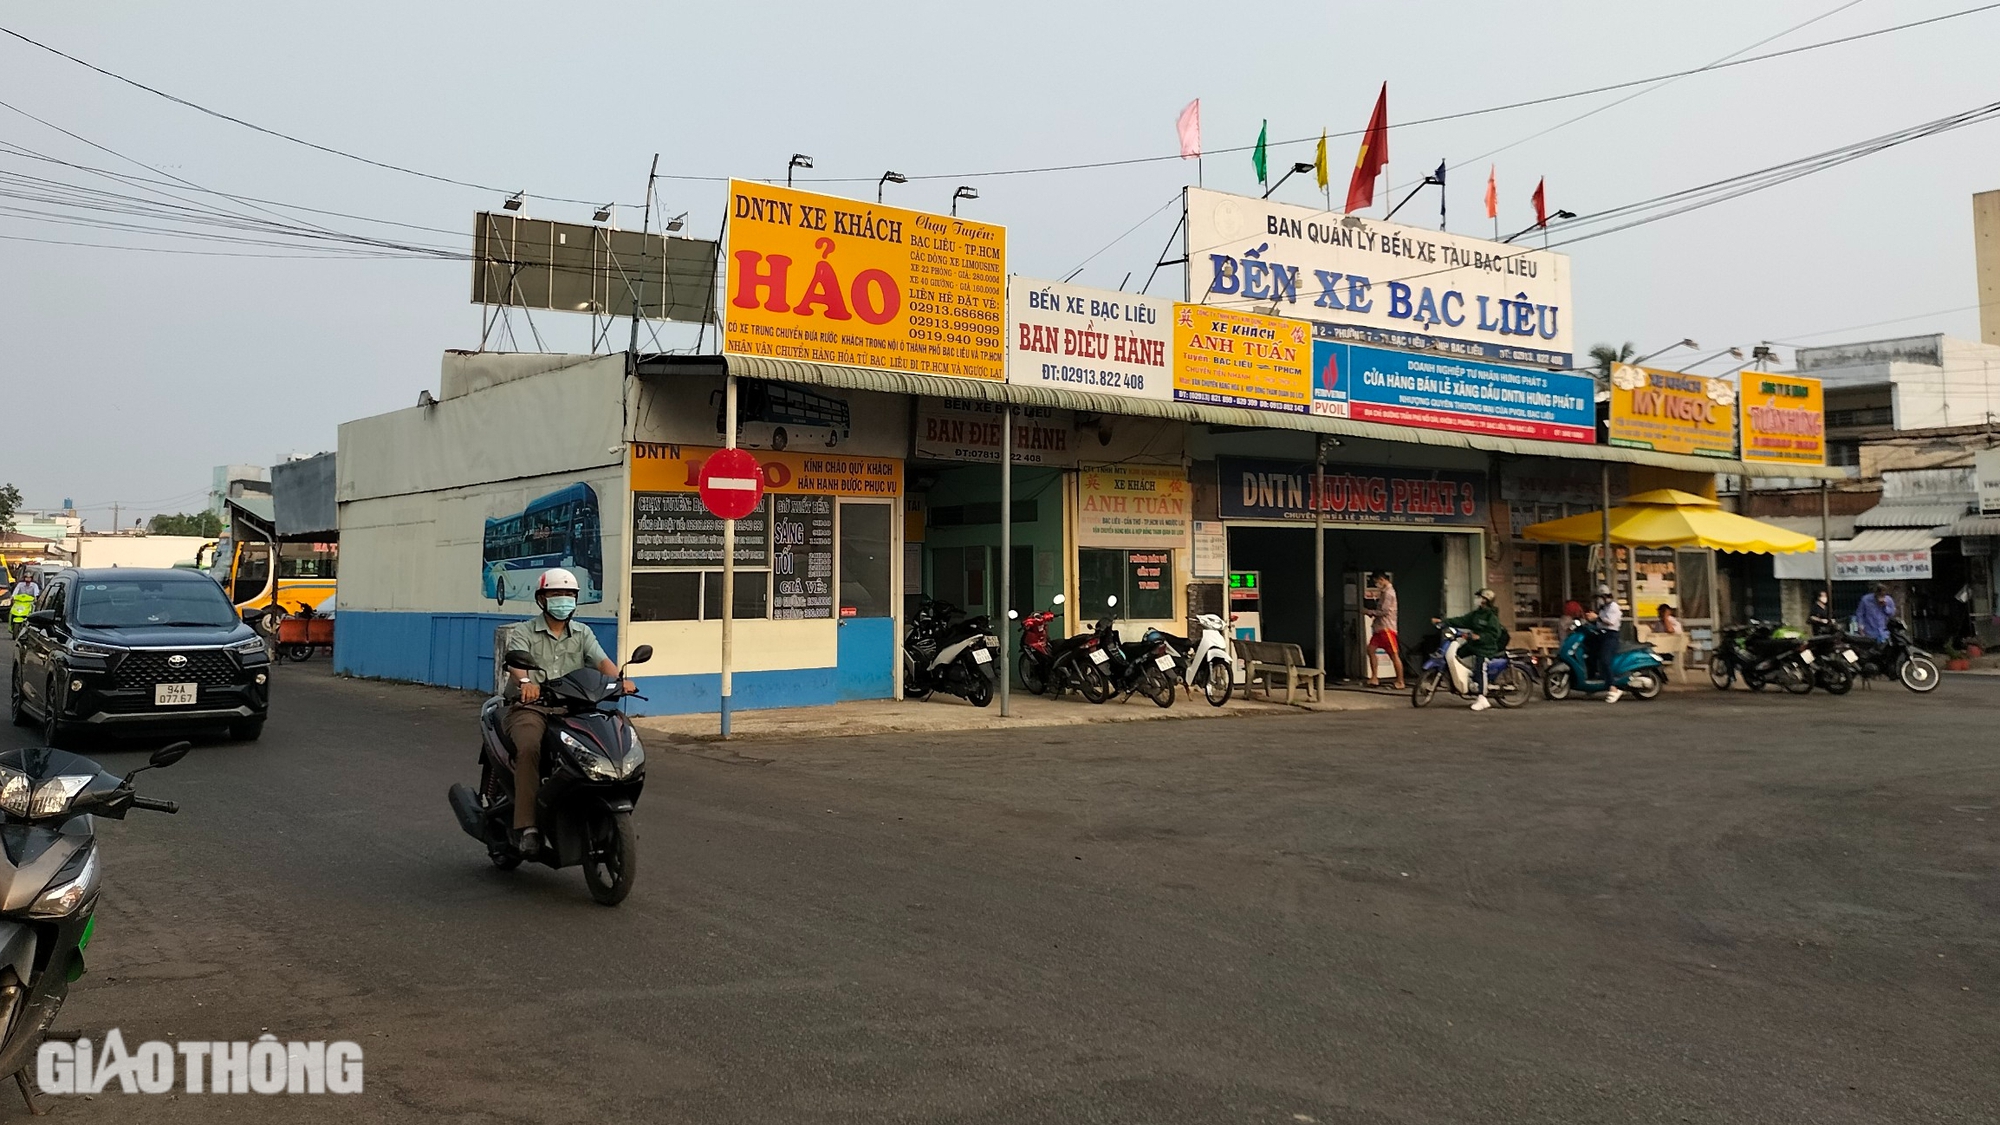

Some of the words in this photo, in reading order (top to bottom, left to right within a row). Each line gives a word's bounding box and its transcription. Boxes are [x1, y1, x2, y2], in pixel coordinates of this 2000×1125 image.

[736, 195, 792, 225] DNTN
[799, 205, 827, 231] XE
[834, 210, 902, 243] KHÁCH
[916, 215, 947, 235] Chạy
[952, 222, 994, 240] Tuyến:
[910, 235, 930, 249] BẠC
[934, 238, 955, 252] LIÊU
[965, 244, 1000, 259] TP.HCM
[1268, 215, 1302, 239] BAN
[1308, 218, 1353, 248] QUẢN
[1358, 228, 1378, 251] LÝ
[1417, 240, 1436, 263] XE
[1441, 242, 1470, 266] TÀU
[1474, 251, 1501, 275] BẠC
[1506, 255, 1537, 278] LIÊU
[910, 250, 925, 261] CÁC
[927, 252, 947, 265] DÒNG
[950, 257, 959, 267] XE
[962, 259, 999, 272] LIMOUSINE
[921, 265, 929, 273] 22
[931, 266, 952, 276] PHÒNG
[733, 237, 901, 325] HẢO
[921, 277, 928, 285] 40
[930, 279, 954, 289] GIƯỜNG
[1209, 243, 1299, 304] BẾN
[1314, 270, 1373, 313] XE
[1387, 281, 1465, 331] BẠC
[1476, 292, 1558, 339] LIÊU
[909, 288, 934, 301] LIÊN
[939, 292, 953, 305] HỆ
[958, 295, 979, 307] ĐẶT
[983, 298, 999, 309] VÉ:
[1030, 287, 1060, 311] BẾN
[1066, 296, 1084, 315] XE
[1091, 300, 1120, 321] BẠC
[1125, 304, 1156, 324] LIÊU
[910, 302, 999, 322] 02913.686868
[909, 316, 999, 335] 02913.999099
[1211, 322, 1228, 333] XE
[1232, 325, 1275, 340] KHÁCH
[728, 322, 737, 332] CÓ
[740, 324, 748, 334] XE
[751, 325, 774, 336] TRUNG
[776, 325, 802, 340] CHUYỂN
[805, 330, 818, 341] ĐƯA
[821, 331, 838, 343] RƯỚC
[842, 335, 863, 347] KHÁCH
[866, 338, 886, 349] TRONG
[888, 341, 898, 351] NỘI
[906, 342, 927, 353] THÀNH
[929, 344, 940, 355] PHỐ
[943, 347, 954, 358] BẠC
[956, 349, 969, 358] LIÊU
[971, 350, 978, 359] VÀ
[981, 351, 1002, 362] TP.HCM
[909, 329, 971, 344] 0919.940
[976, 337, 999, 347] 990
[1019, 323, 1059, 354] BAN
[1064, 320, 1109, 360] ĐIỀU
[1114, 330, 1165, 367] HÀNH
[1189, 334, 1234, 353] ANH
[1243, 340, 1297, 362] TUẤN
[728, 339, 752, 353] NHẬN
[756, 342, 773, 356] VẬN
[776, 343, 809, 358] CHUYỂN
[812, 348, 835, 361] HÀNG
[838, 349, 854, 363] HÓA
[857, 352, 868, 364] TỪ
[870, 355, 886, 367] BẠC
[890, 356, 908, 368] LIÊU
[910, 360, 918, 369] ĐI
[921, 361, 949, 373] TP.HCM
[951, 362, 961, 374] VÀ
[964, 365, 987, 377] NGƯỢC
[990, 369, 1002, 378] LẠI
[1214, 357, 1230, 365] BẠC
[1234, 360, 1252, 368] LIÊU
[1274, 366, 1301, 375] TPHCM
[1407, 360, 1435, 373] DOANH
[1124, 373, 1143, 390] 408
[1364, 367, 1385, 386] CỬA
[1386, 372, 1415, 390] HÀNG
[1417, 376, 1437, 393] BÁN
[1440, 377, 1451, 395] LẺ
[1453, 381, 1479, 398] XĂNG
[1502, 389, 1525, 403] DNTN
[1526, 391, 1551, 406] HƯNG
[1552, 393, 1575, 410] PHÁT
[974, 402, 991, 413] XE
[1315, 402, 1345, 415] PVOIL
[1632, 388, 1665, 416] MỸ
[1665, 395, 1718, 428] NGỌC
[926, 417, 964, 443] BAN
[1017, 421, 1067, 450] HÀNH
[636, 443, 680, 459] DNTN
[1024, 454, 1041, 462] 408
[804, 458, 822, 473] KÍNH
[826, 459, 847, 474] CHÀO
[849, 460, 864, 476] QUÝ
[867, 461, 892, 475] KHÁCH
[798, 475, 814, 489] HÂN
[817, 478, 838, 492] HẠNH
[841, 477, 862, 493] ĐƯỢC
[864, 480, 885, 494] PHỤC
[887, 481, 897, 495] VỤ
[1114, 480, 1126, 490] XE
[1128, 478, 1155, 491] KHÁCH
[1242, 471, 1303, 509] DNTN
[1392, 470, 1457, 515] PHÁT
[1461, 481, 1475, 516] 3
[1083, 495, 1127, 513] ANH
[1133, 493, 1183, 514] TUẤN
[775, 517, 804, 544] SÁNG
[774, 545, 794, 575] TỐI
[780, 578, 803, 594] GIÁ
[805, 578, 828, 593] VÉ:
[160, 694, 192, 703] 077.67
[168, 685, 185, 693] 94A
